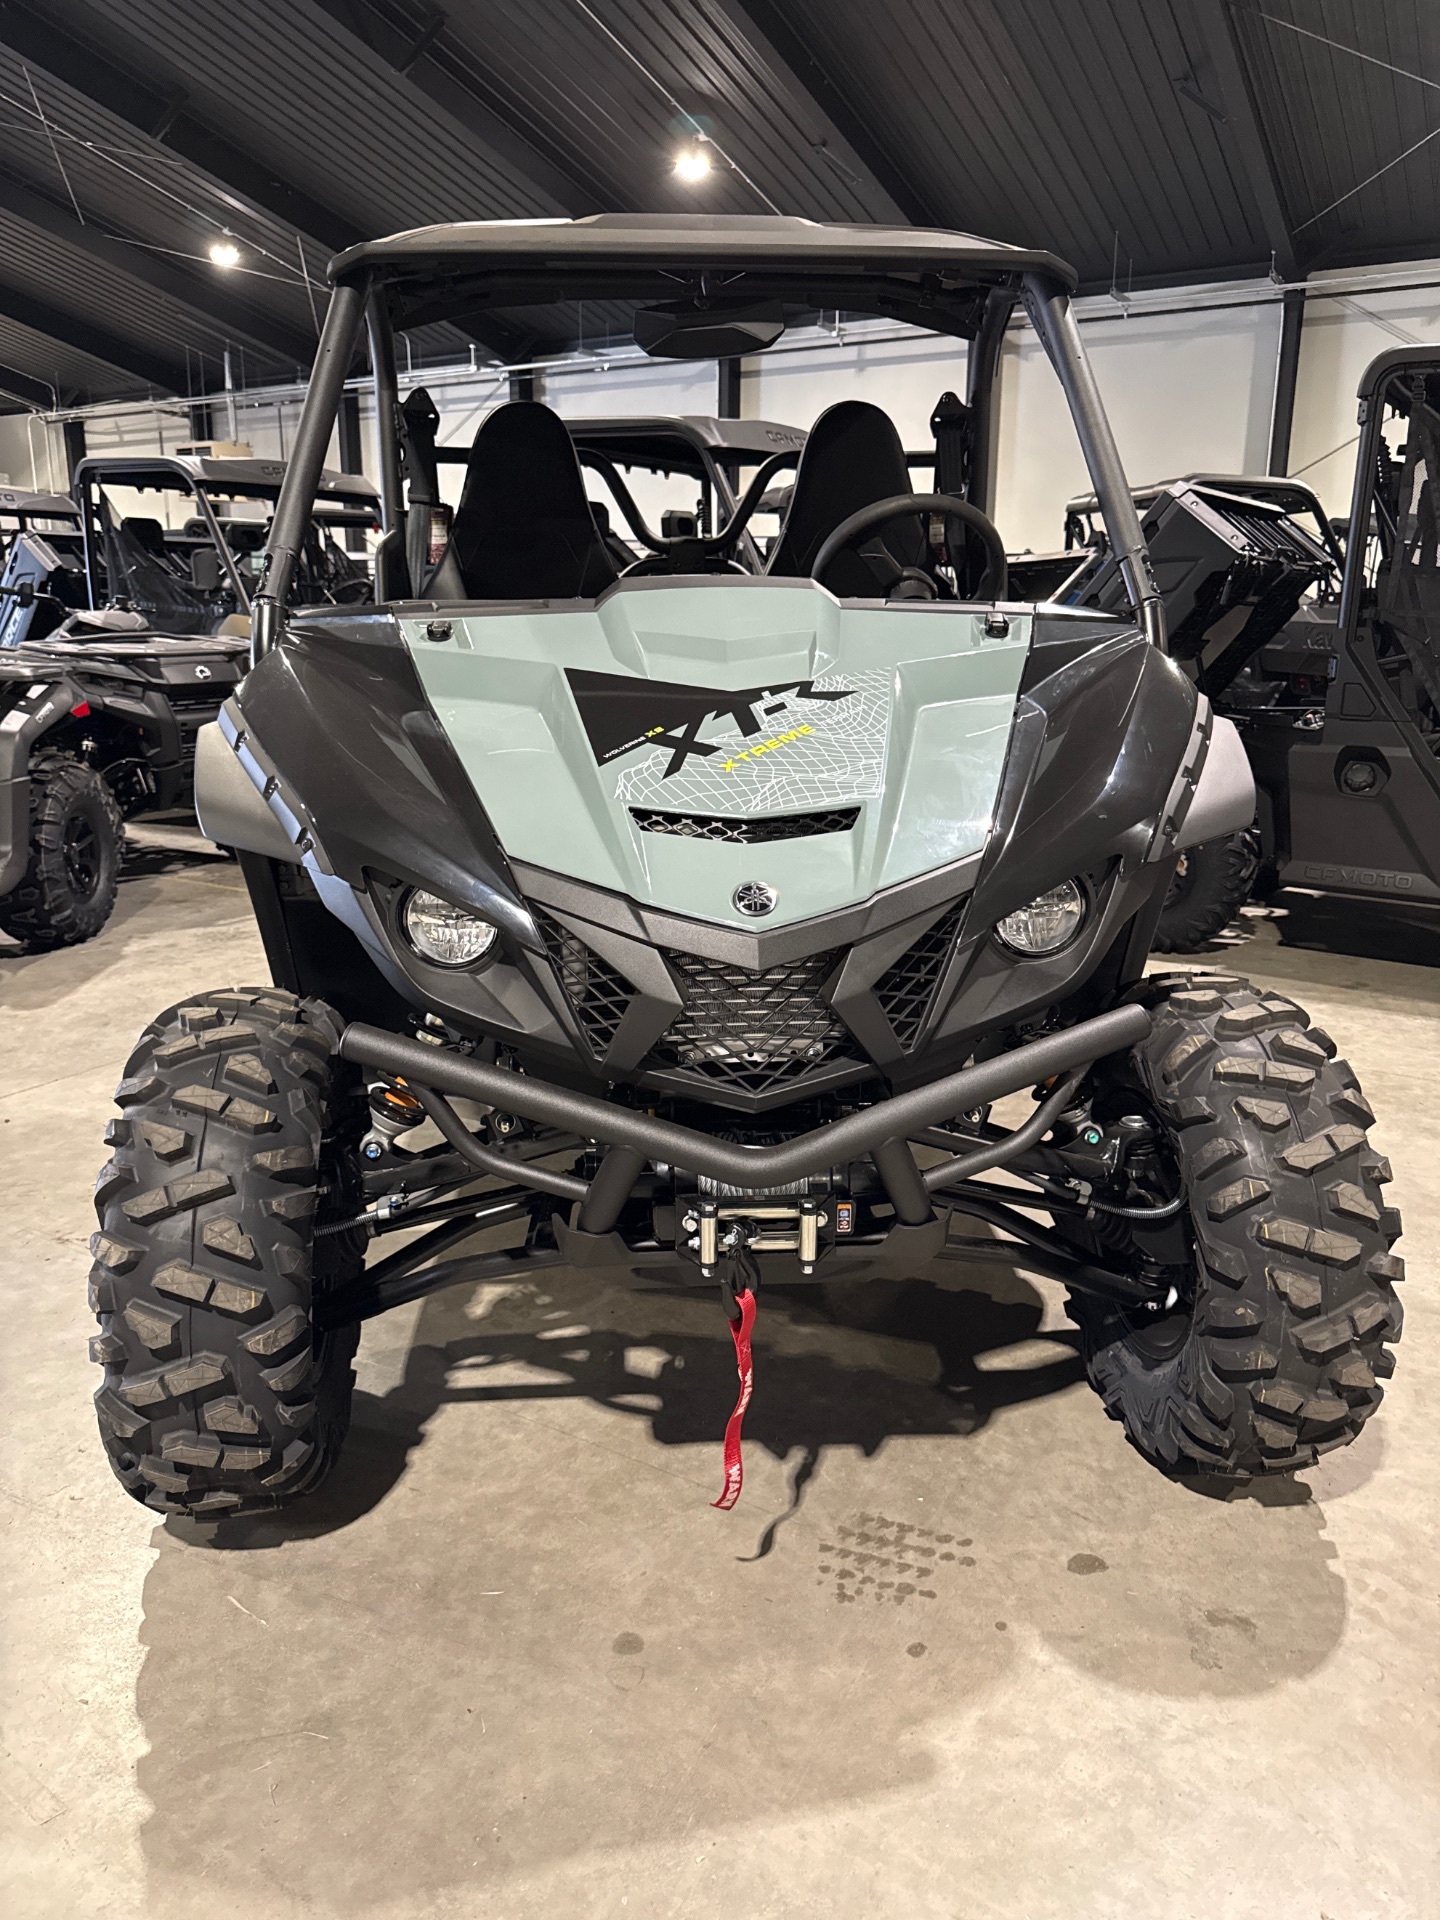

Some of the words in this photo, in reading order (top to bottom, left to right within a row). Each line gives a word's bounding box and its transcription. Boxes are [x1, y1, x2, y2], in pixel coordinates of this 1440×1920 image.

[603, 736, 647, 758] WOLVERINE
[1304, 865, 1413, 890] CFMOTO
[718, 1462, 741, 1507] WARN
